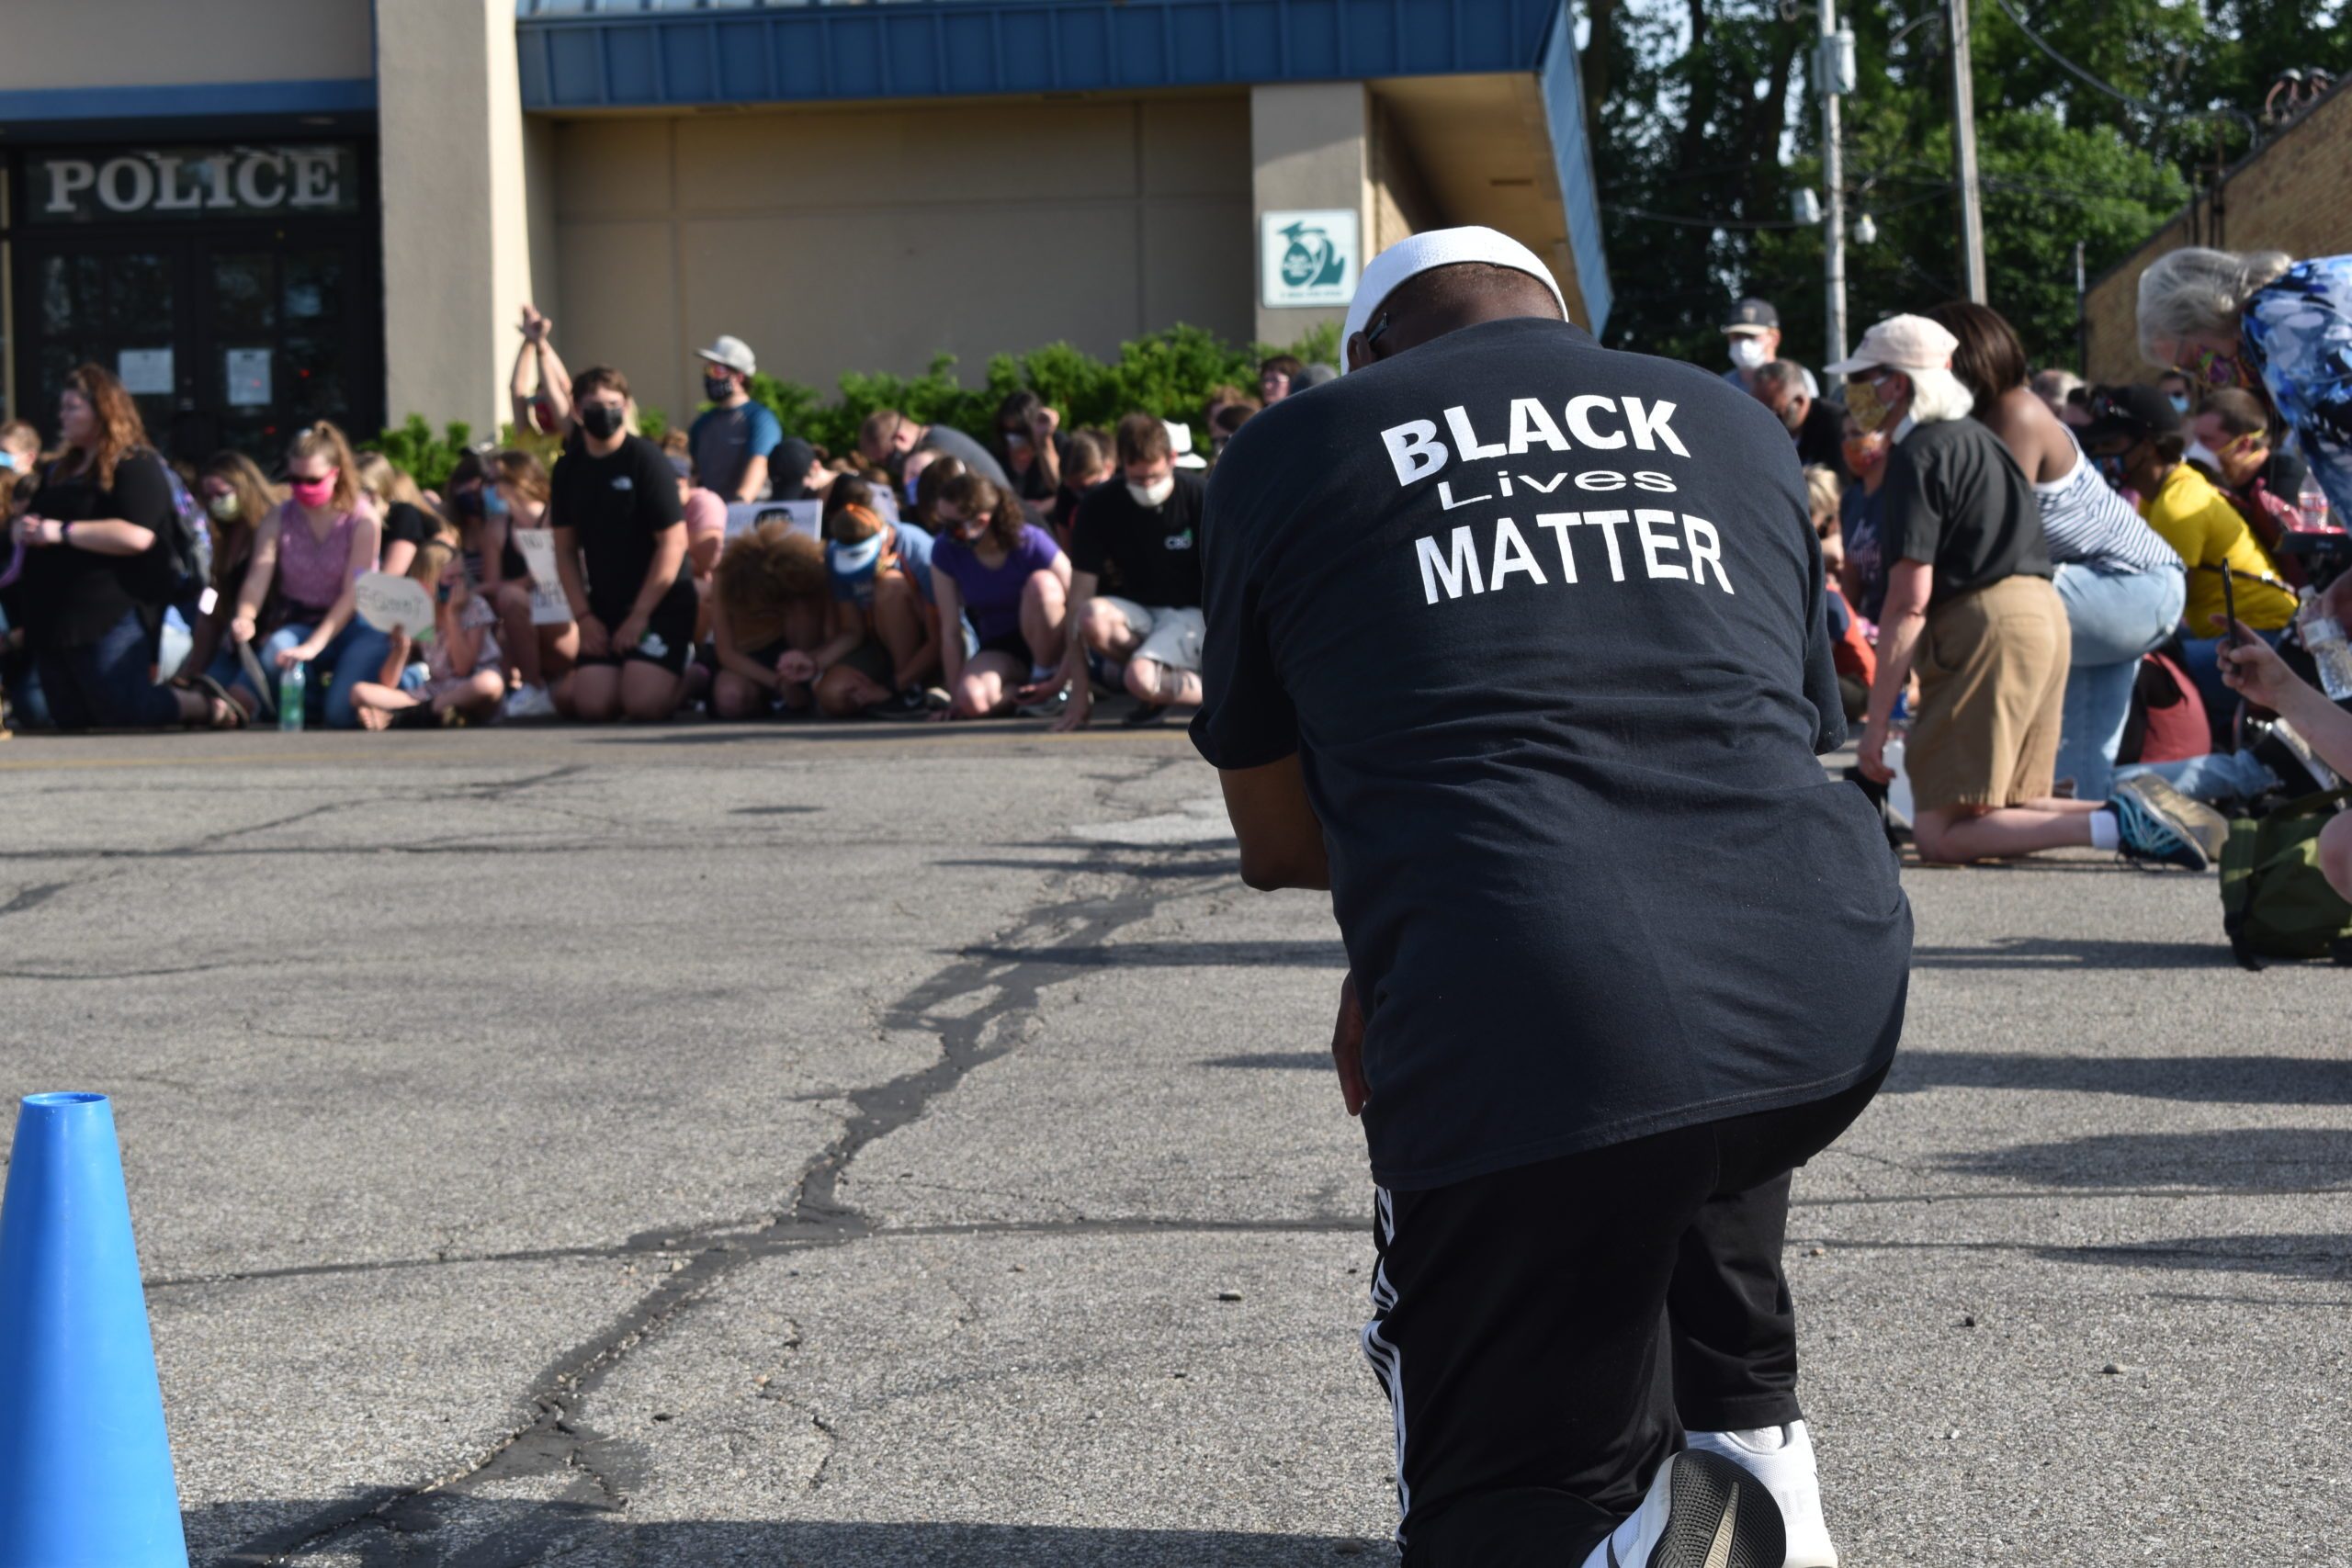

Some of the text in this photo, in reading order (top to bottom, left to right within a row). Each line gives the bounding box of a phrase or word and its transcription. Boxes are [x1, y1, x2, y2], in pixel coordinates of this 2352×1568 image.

[45, 152, 339, 212] POLICE
[1380, 394, 1691, 487] BLACK
[1437, 469, 1679, 512] Lives
[1415, 508, 1735, 605] MATTER
